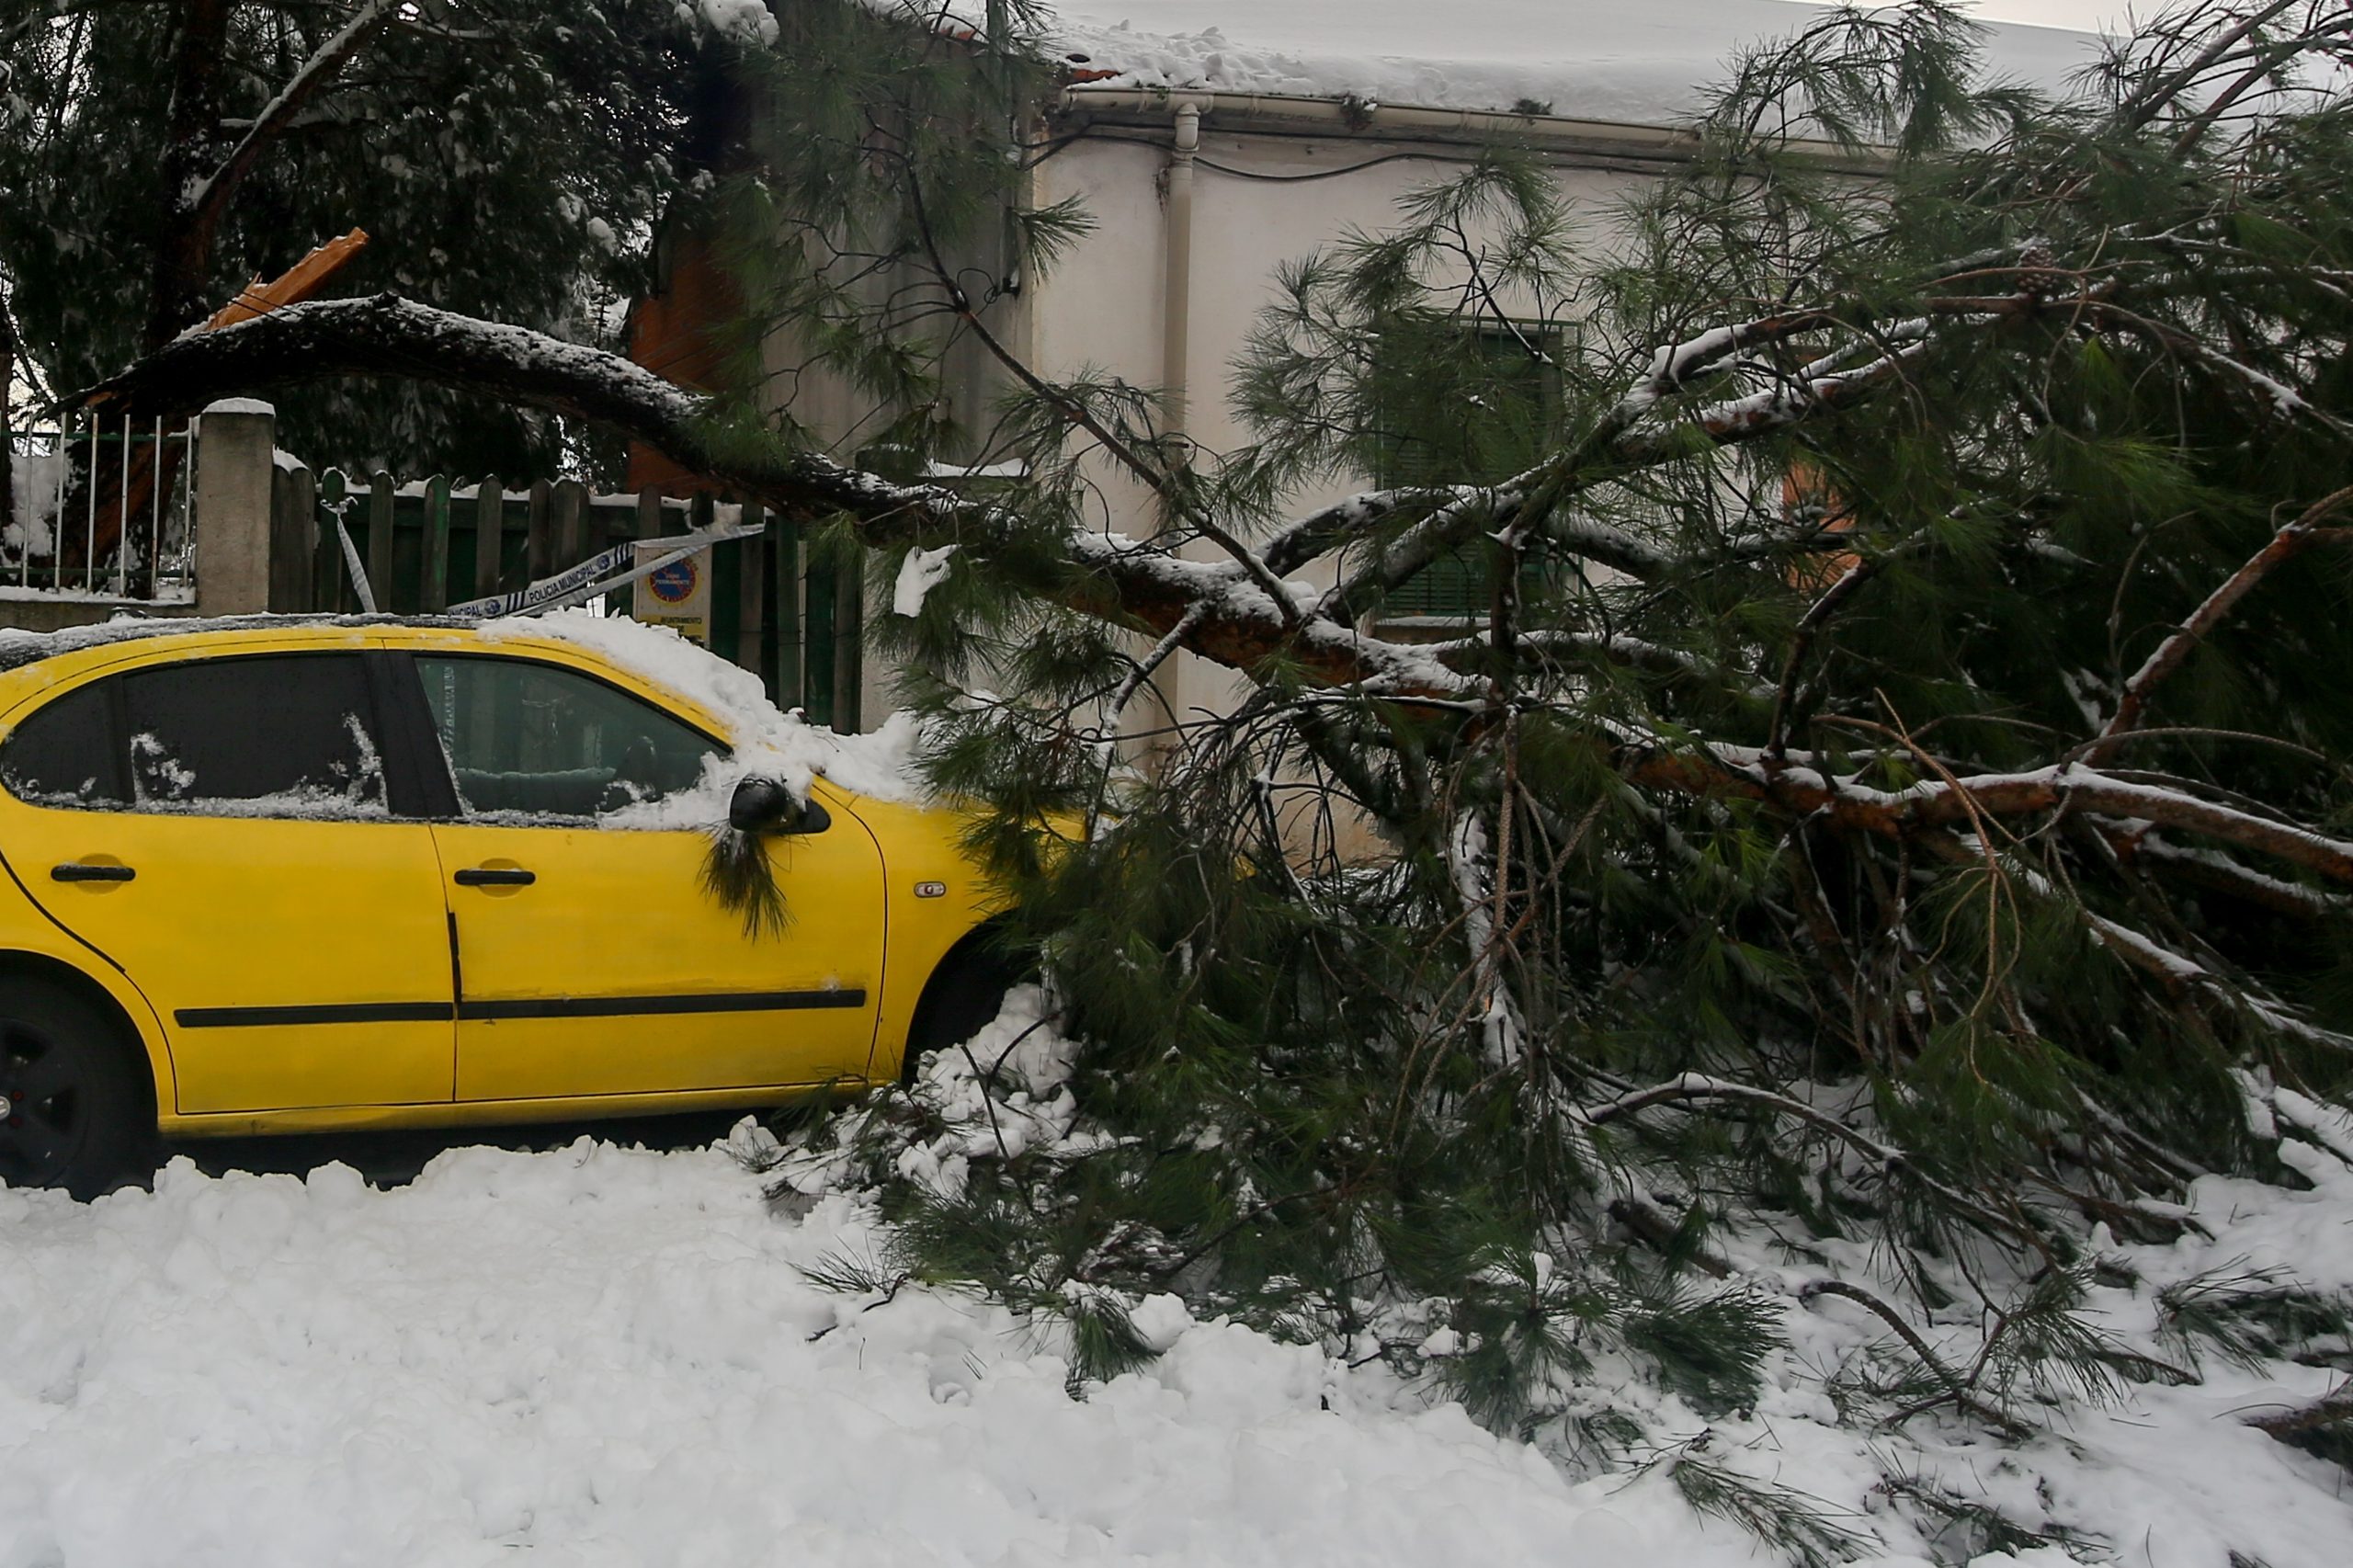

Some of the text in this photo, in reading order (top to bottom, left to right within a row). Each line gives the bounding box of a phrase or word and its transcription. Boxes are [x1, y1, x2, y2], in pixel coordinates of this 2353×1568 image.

[529, 563, 597, 603] POLICIA MUNICIPAL
[448, 605, 483, 618] UNICIPAL
